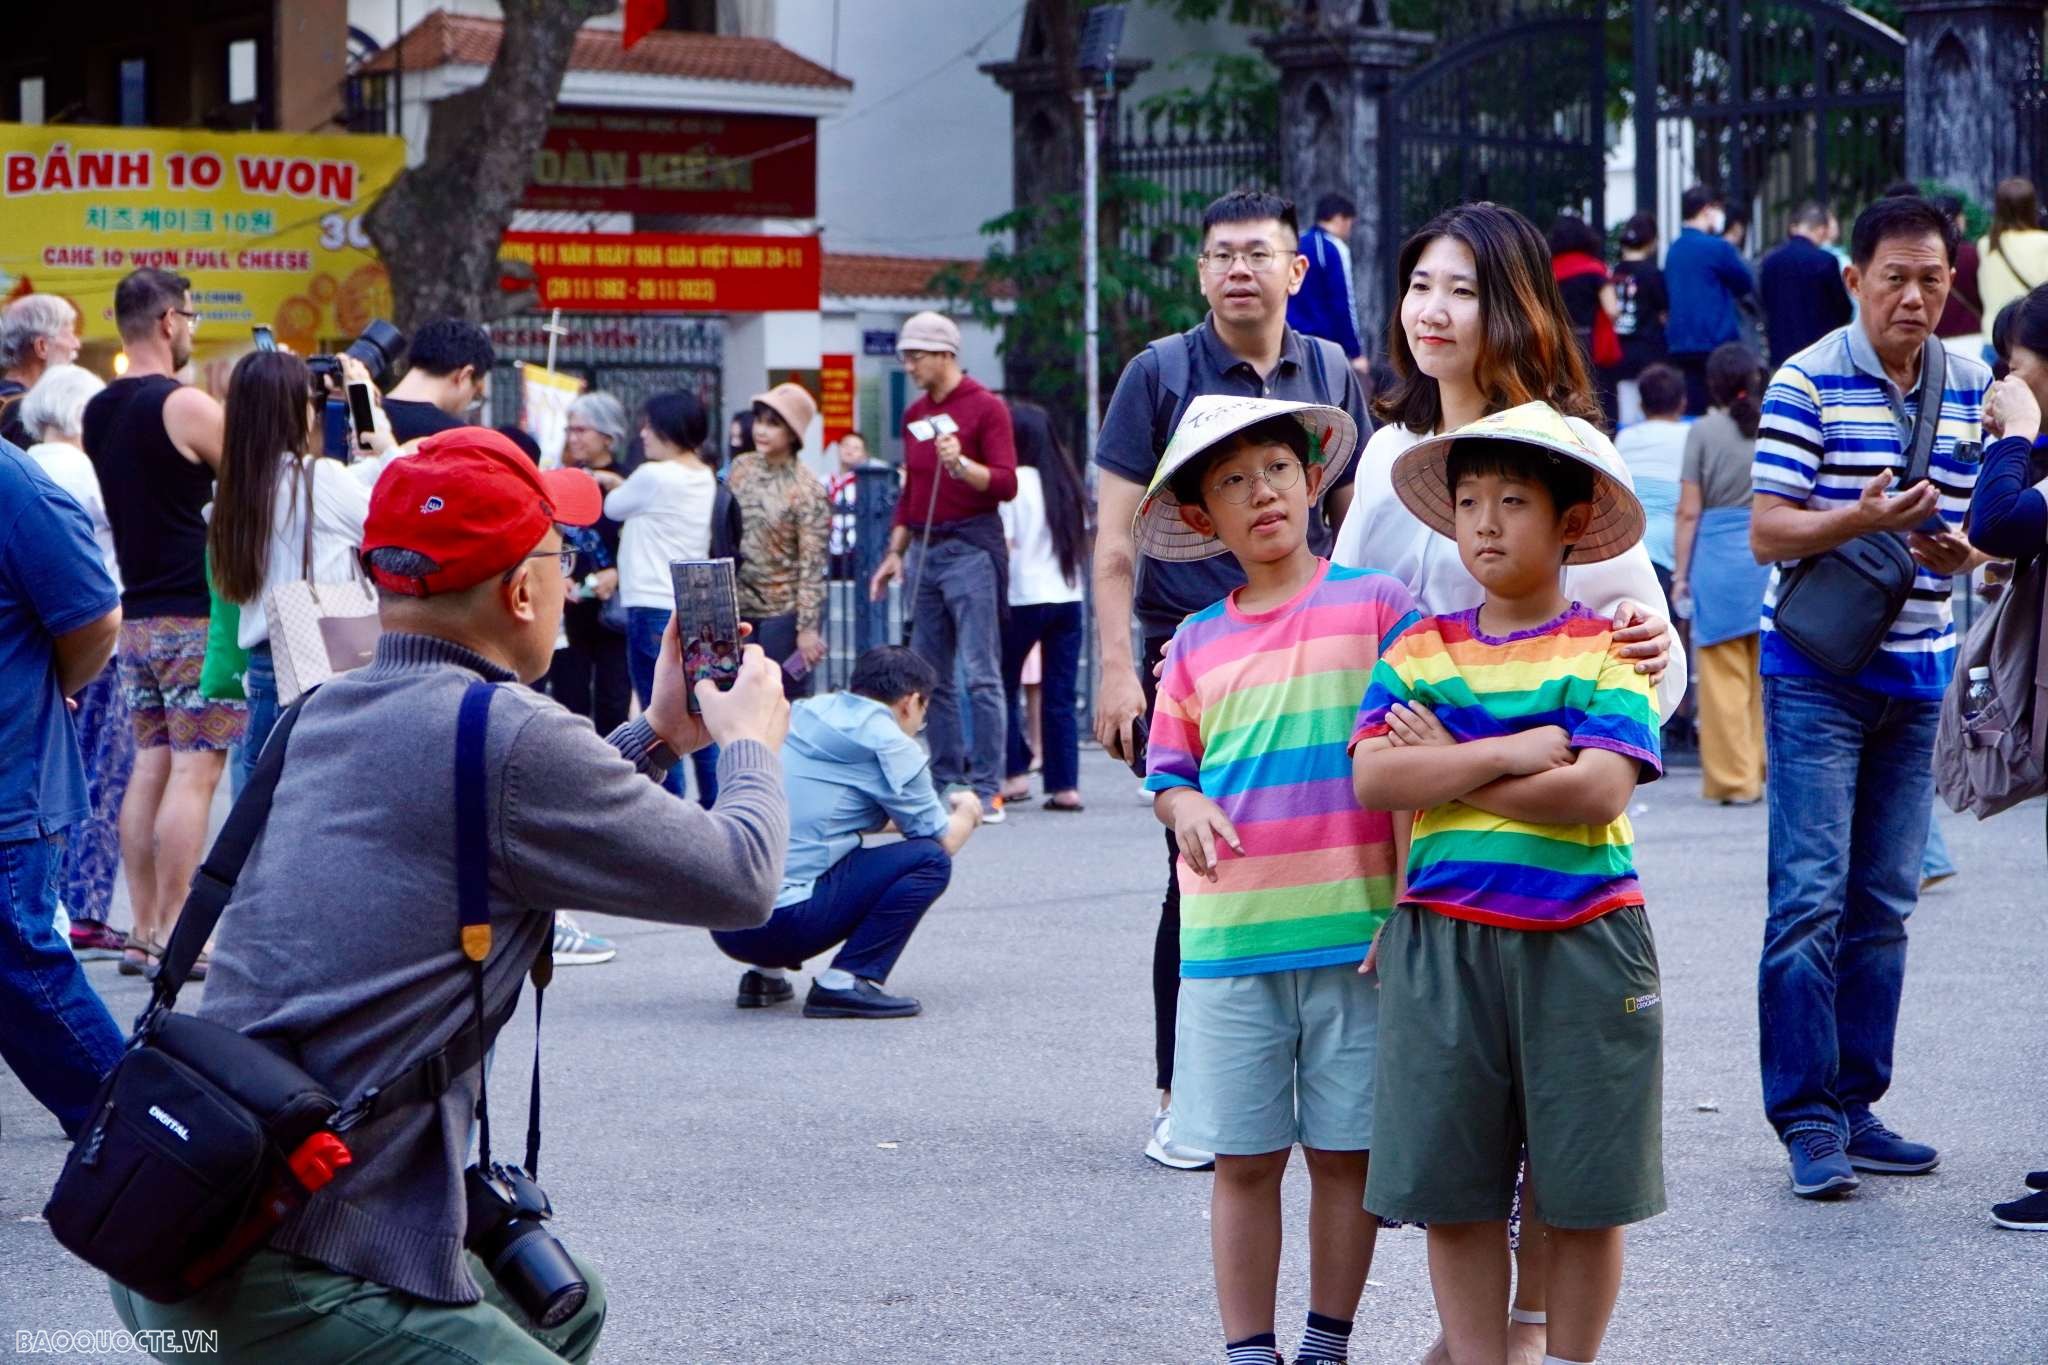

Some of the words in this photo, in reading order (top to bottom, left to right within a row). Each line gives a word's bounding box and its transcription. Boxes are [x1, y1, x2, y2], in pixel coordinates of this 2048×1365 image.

[6, 144, 151, 194] BÁNH
[168, 154, 223, 188] 10
[238, 157, 355, 202] WON
[533, 137, 628, 187] OÀN
[130, 249, 179, 269] WON
[184, 250, 230, 269] FULL
[236, 251, 310, 271] CHEESE
[148, 1104, 190, 1141] DIGITAL
